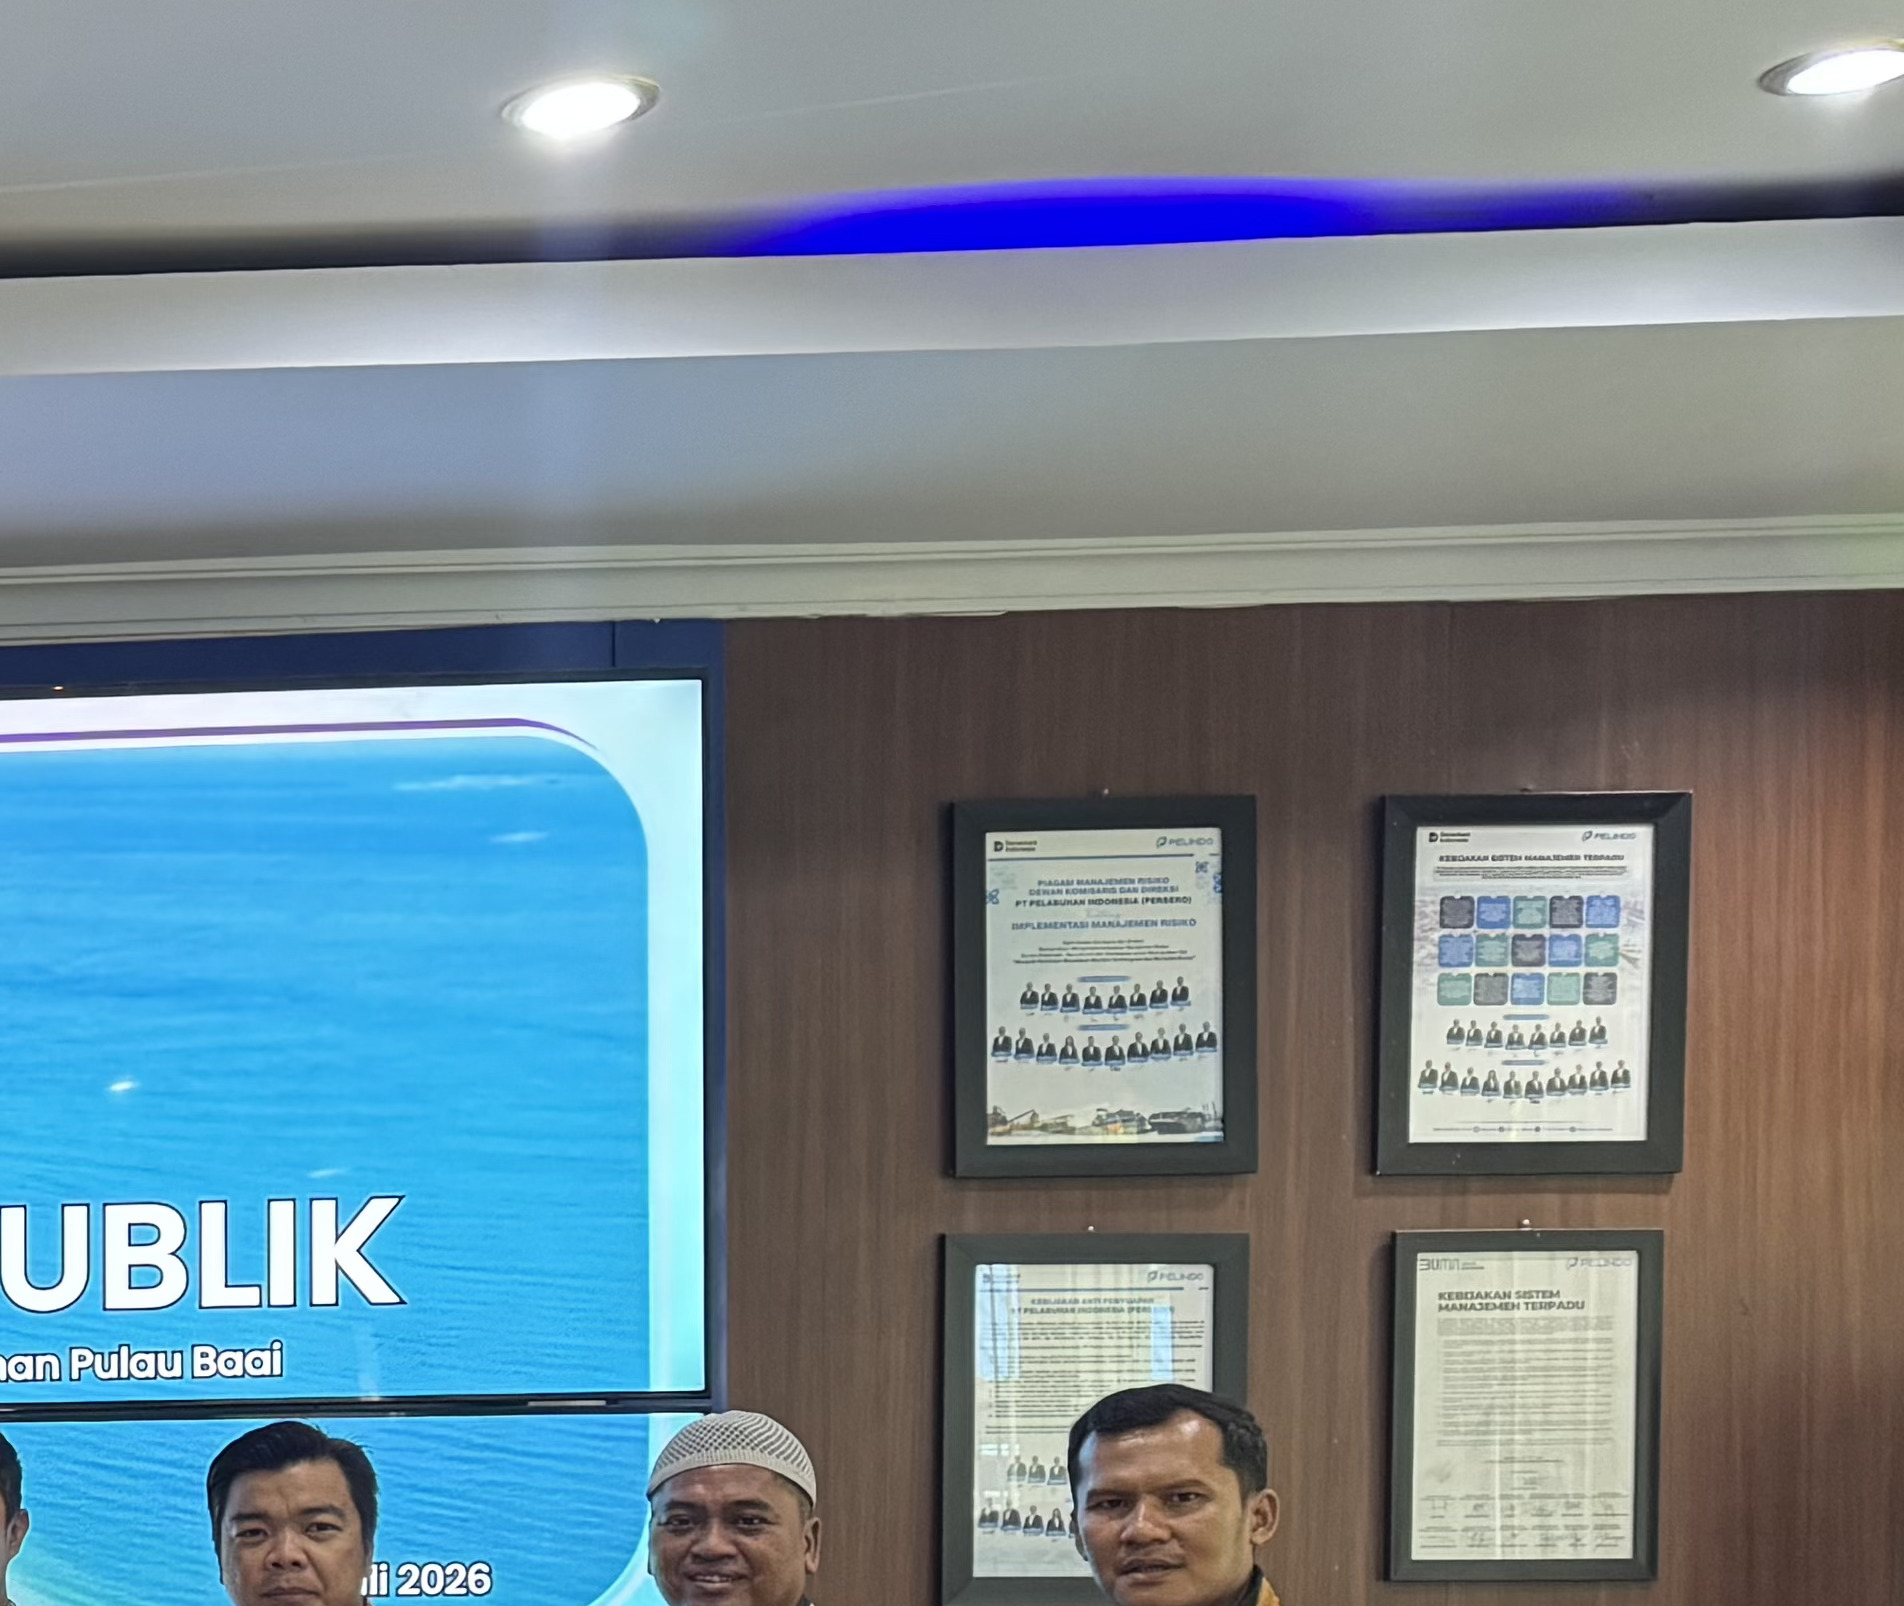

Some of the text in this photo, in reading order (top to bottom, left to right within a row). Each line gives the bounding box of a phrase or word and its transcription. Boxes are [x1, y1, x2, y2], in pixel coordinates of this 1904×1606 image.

[69, 1343, 183, 1382] Pulau
[191, 1339, 284, 1379] Baai
[395, 1561, 493, 1597] 2026
